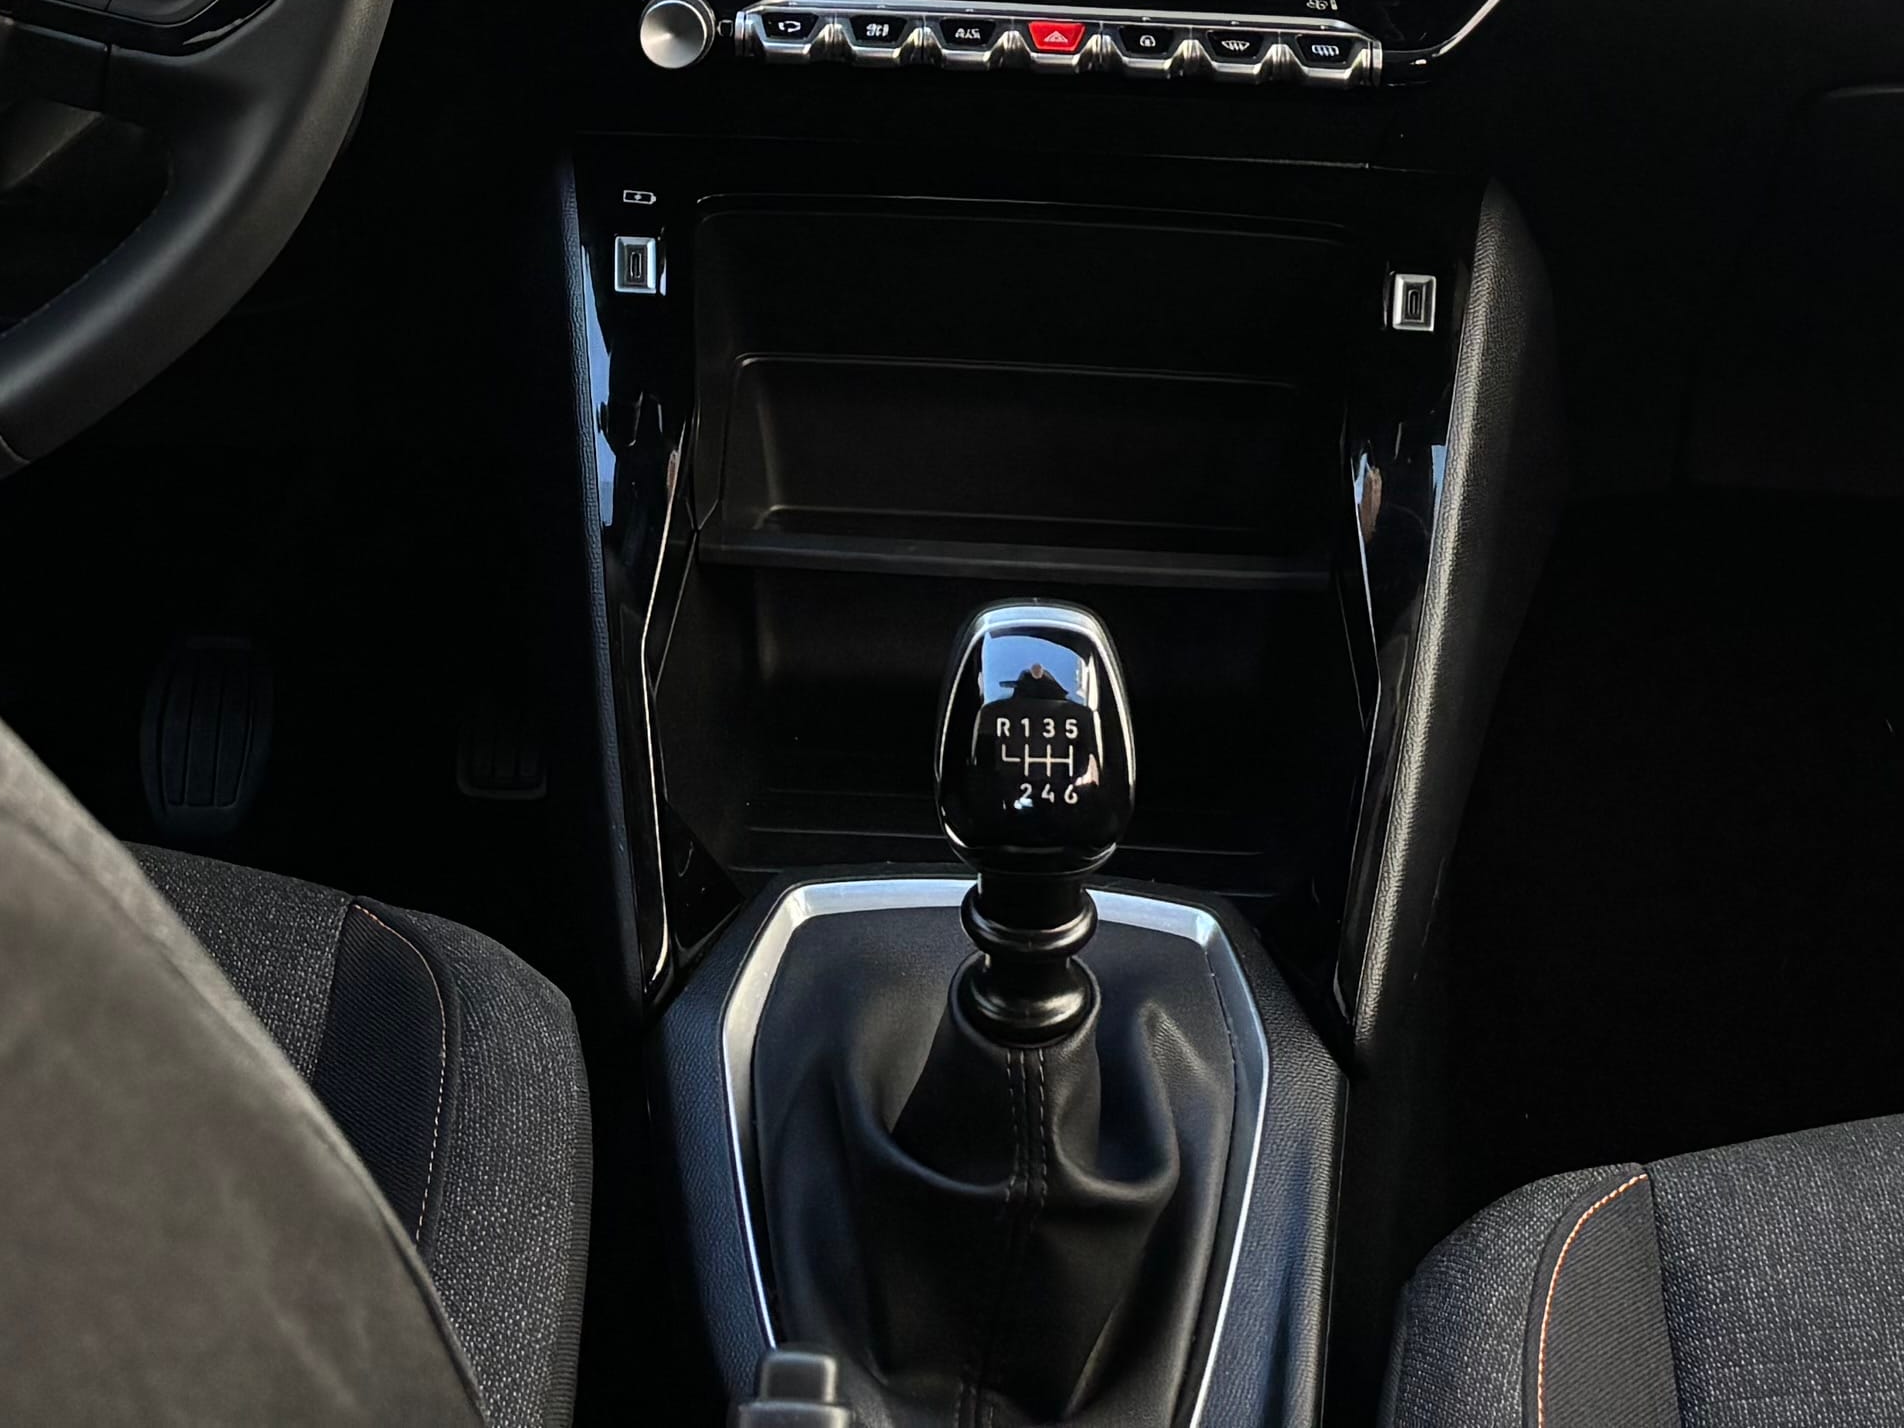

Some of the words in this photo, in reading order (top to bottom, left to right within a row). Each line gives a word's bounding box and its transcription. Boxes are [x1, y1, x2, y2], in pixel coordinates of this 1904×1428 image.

[996, 717, 1011, 738] R
[1020, 717, 1030, 738] 1
[1042, 717, 1056, 739] 3
[1064, 718, 1079, 740] 5
[1019, 782, 1034, 807] 2
[1041, 783, 1055, 804] 4
[1064, 784, 1079, 804] 6
